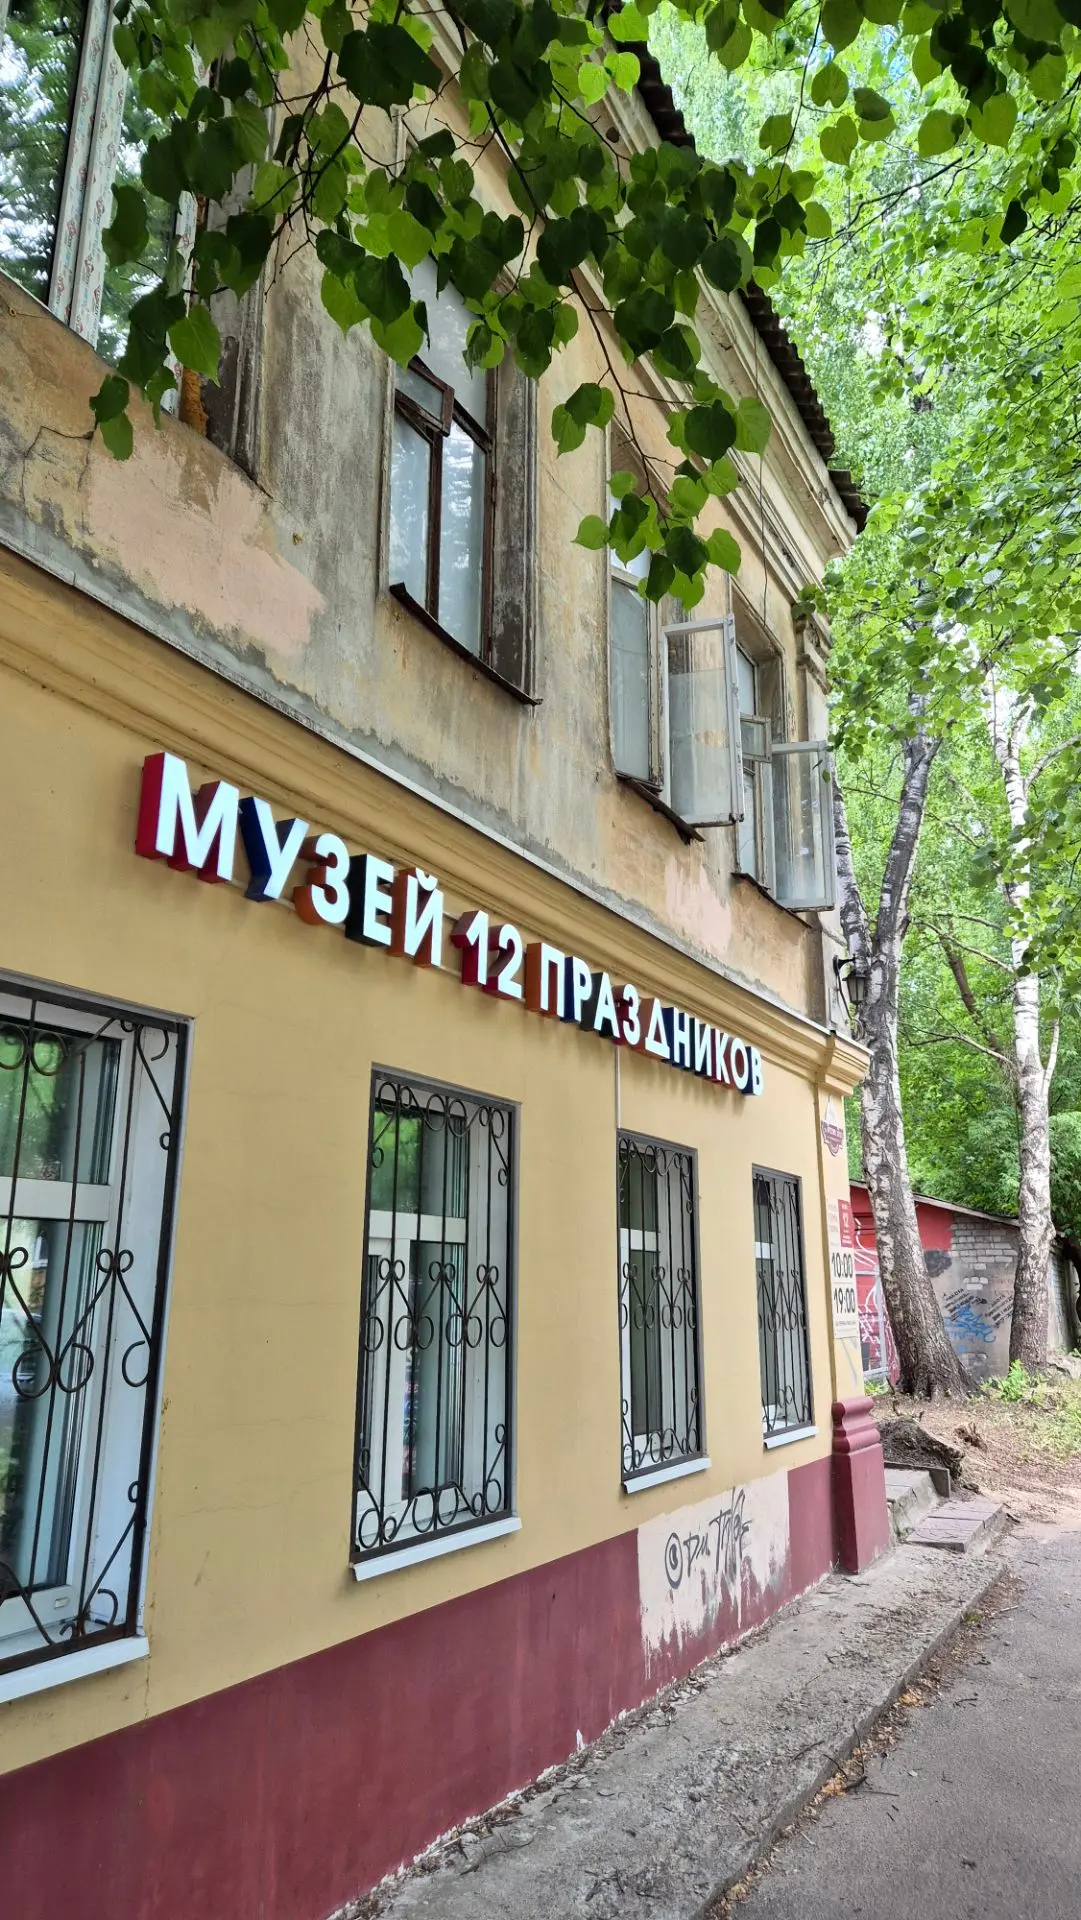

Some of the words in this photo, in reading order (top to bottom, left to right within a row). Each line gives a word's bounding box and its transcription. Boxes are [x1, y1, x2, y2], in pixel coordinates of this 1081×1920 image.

[150, 752, 444, 967] МУЗЕЙ
[461, 910, 523, 999] 12
[535, 943, 764, 1096] ПРАЗДНИКОВ
[831, 1252, 854, 1278] 10:00
[833, 1287, 856, 1313] 19:00
